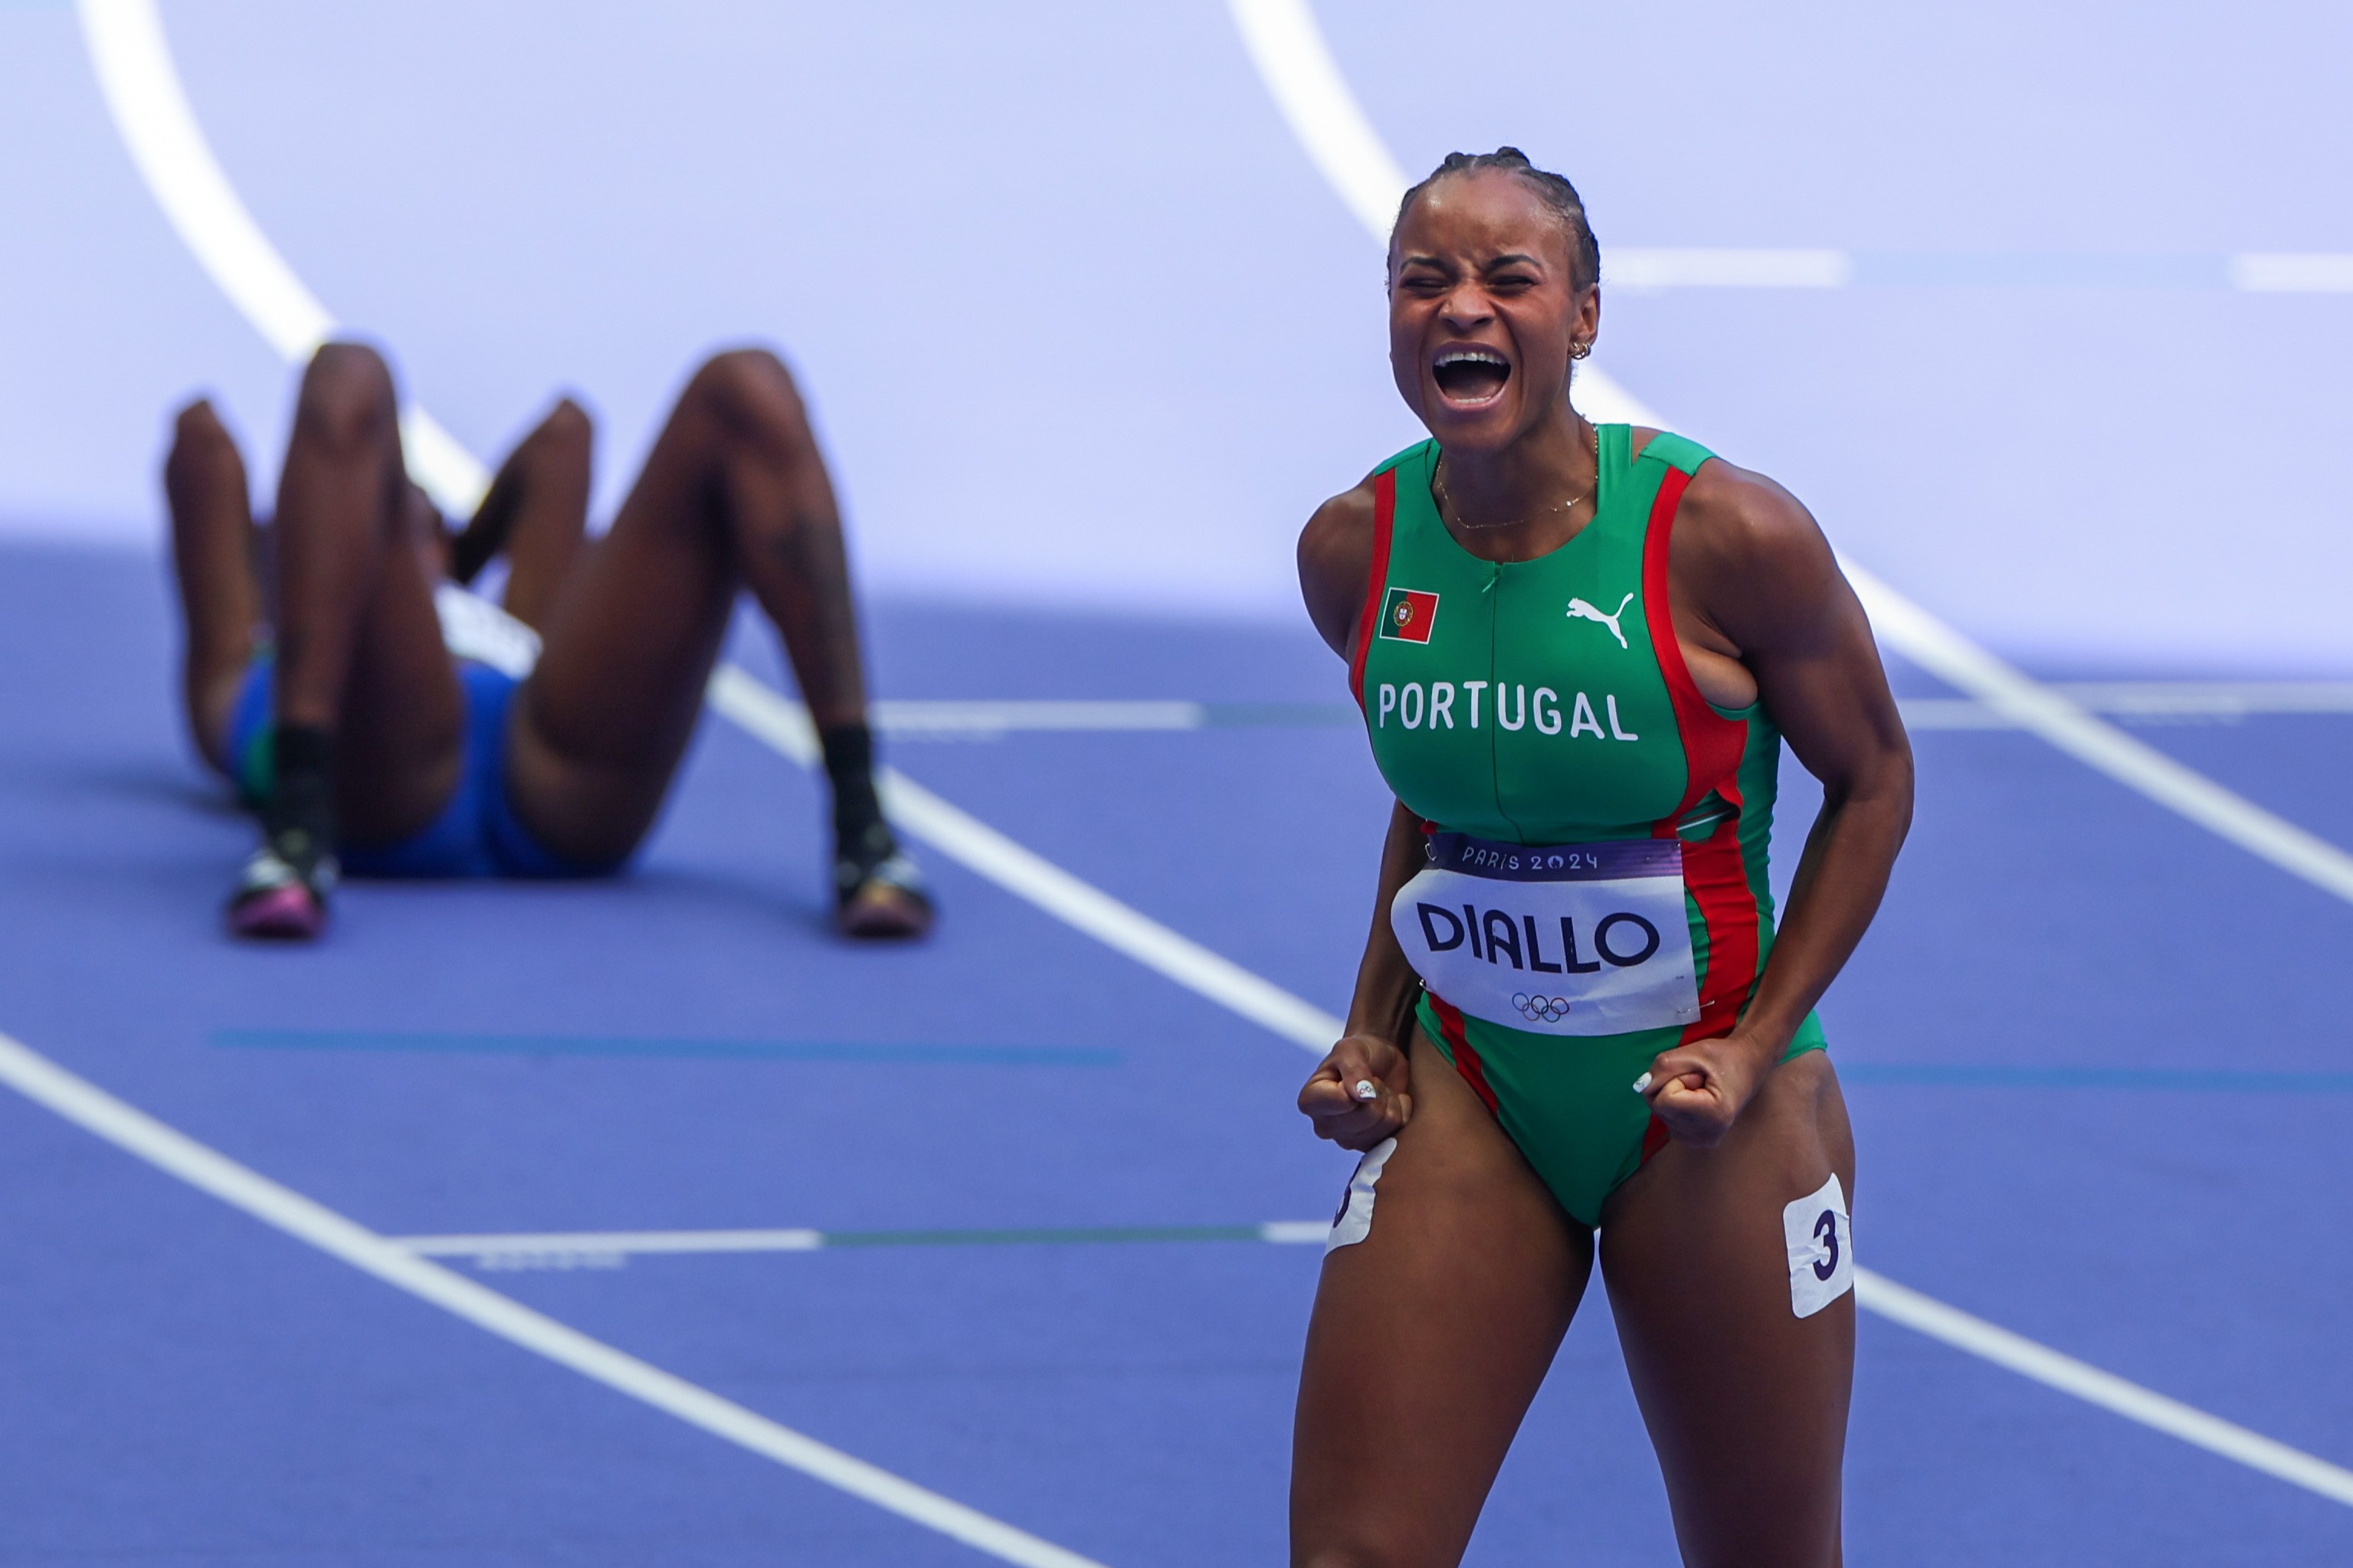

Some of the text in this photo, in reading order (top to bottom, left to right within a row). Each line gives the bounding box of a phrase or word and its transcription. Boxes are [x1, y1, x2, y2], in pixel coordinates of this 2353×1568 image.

[1379, 681, 1638, 741] PORTUGAL
[1532, 853, 1598, 870] 2024
[1416, 902, 1660, 974] DIALLO
[1812, 1209, 1839, 1282] 3
